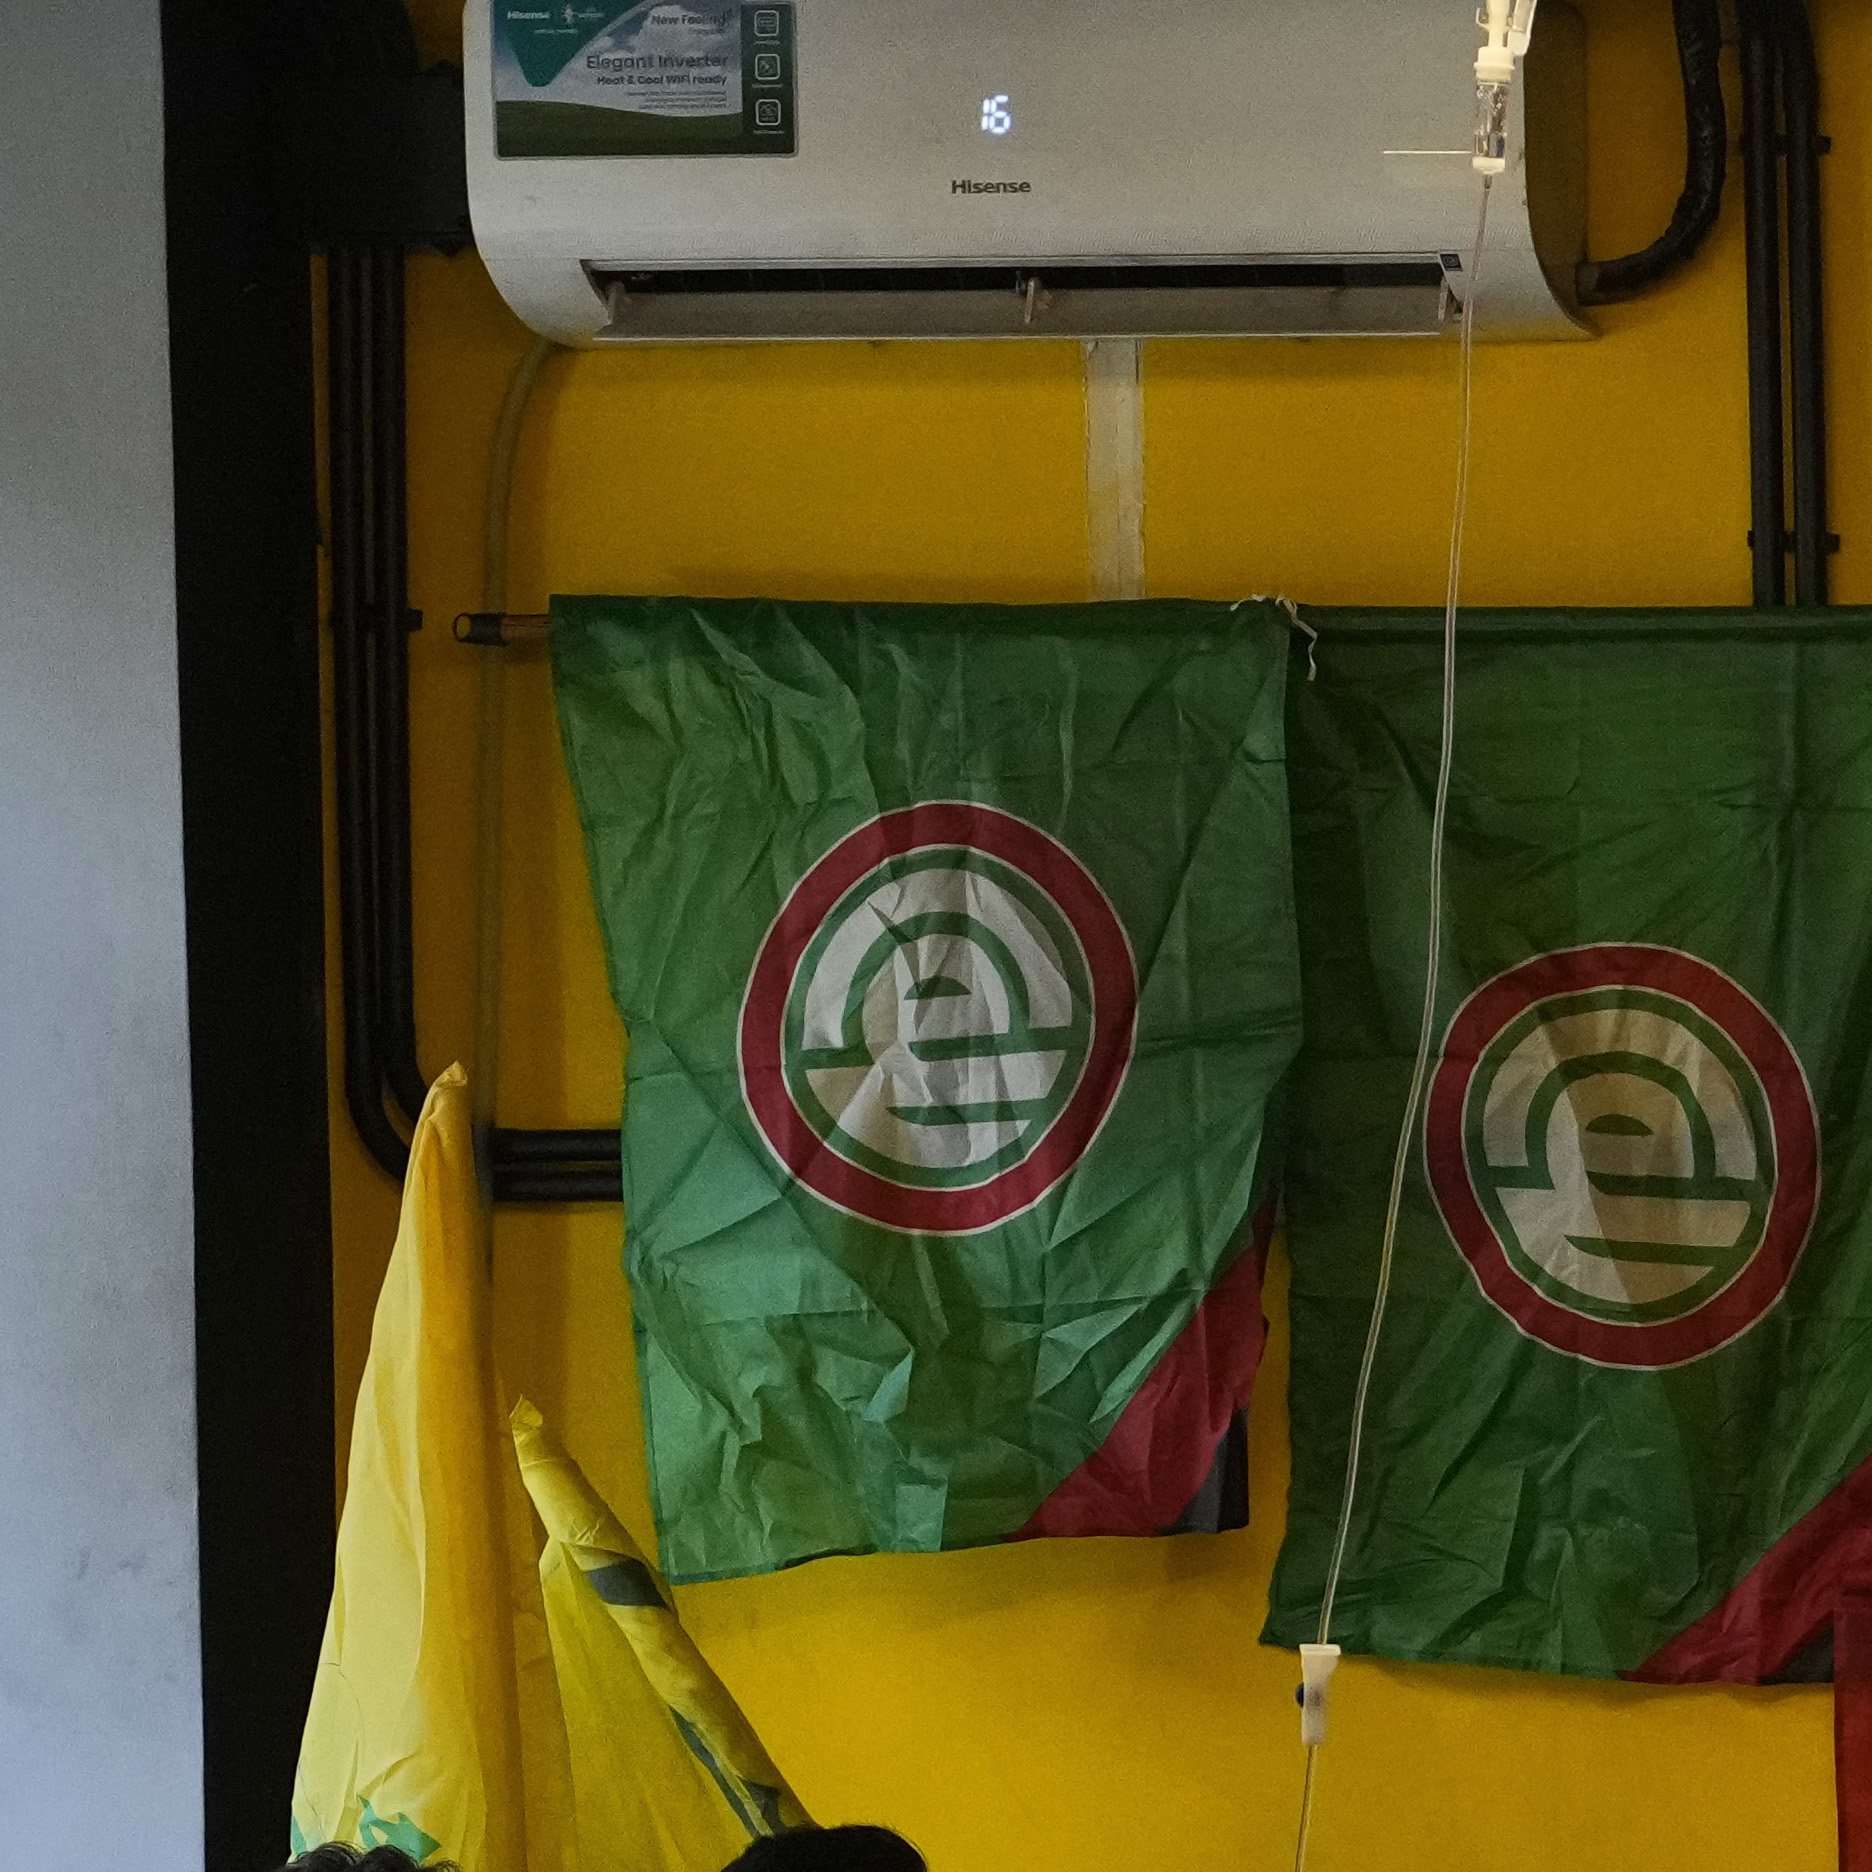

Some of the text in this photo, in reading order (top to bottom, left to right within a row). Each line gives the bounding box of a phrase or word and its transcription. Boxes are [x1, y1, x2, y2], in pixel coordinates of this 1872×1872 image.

[652, 14, 680, 26] New
[586, 54, 729, 72] Elegant Inverter
[637, 75, 665, 86] Cool
[692, 74, 728, 88] ready
[951, 179, 1032, 195] Hisense
